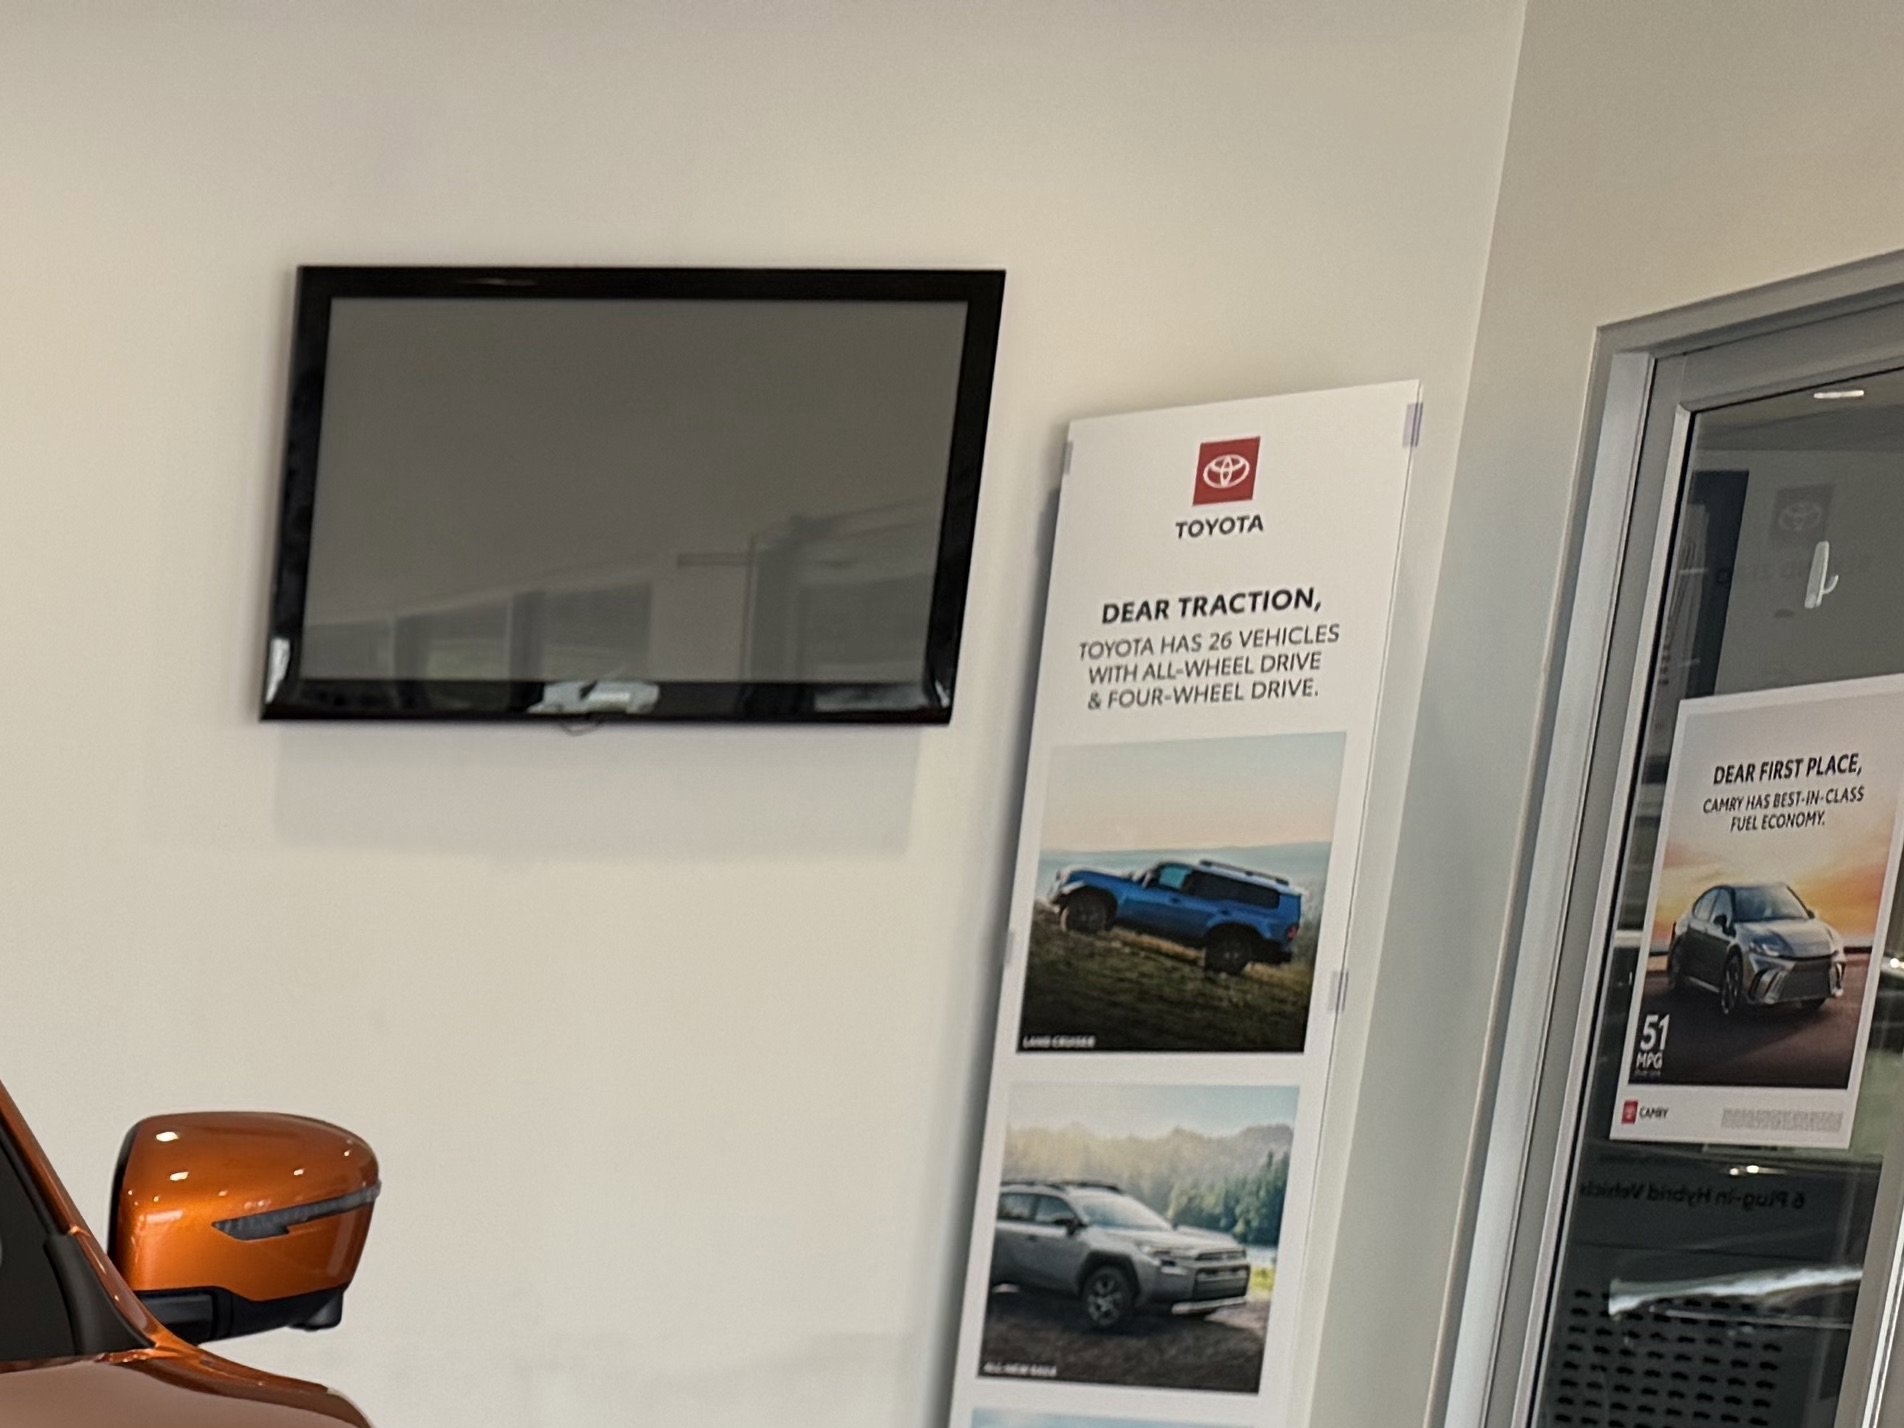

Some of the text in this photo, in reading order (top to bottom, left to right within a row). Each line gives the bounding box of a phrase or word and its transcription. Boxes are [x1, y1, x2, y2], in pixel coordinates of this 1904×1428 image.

[1175, 514, 1264, 539] TOYOTA
[1101, 587, 1322, 624] DEAR TRACTION,
[1079, 623, 1341, 661] TOYOTA HAS 26 VEHICLES
[1088, 651, 1322, 685] WITH ALL-WHEEL DRIVE
[1087, 678, 1319, 710] & FOUR-WHEEL DRIVE.
[1713, 753, 1863, 786] DEAR FIRST PLACE,
[1703, 785, 1865, 814] CAMRY HAS BEST-IN-CLASS
[1730, 810, 1826, 832] FUEL ECONOMY.
[1640, 1014, 1670, 1051] 51
[1635, 1052, 1663, 1069] MPG
